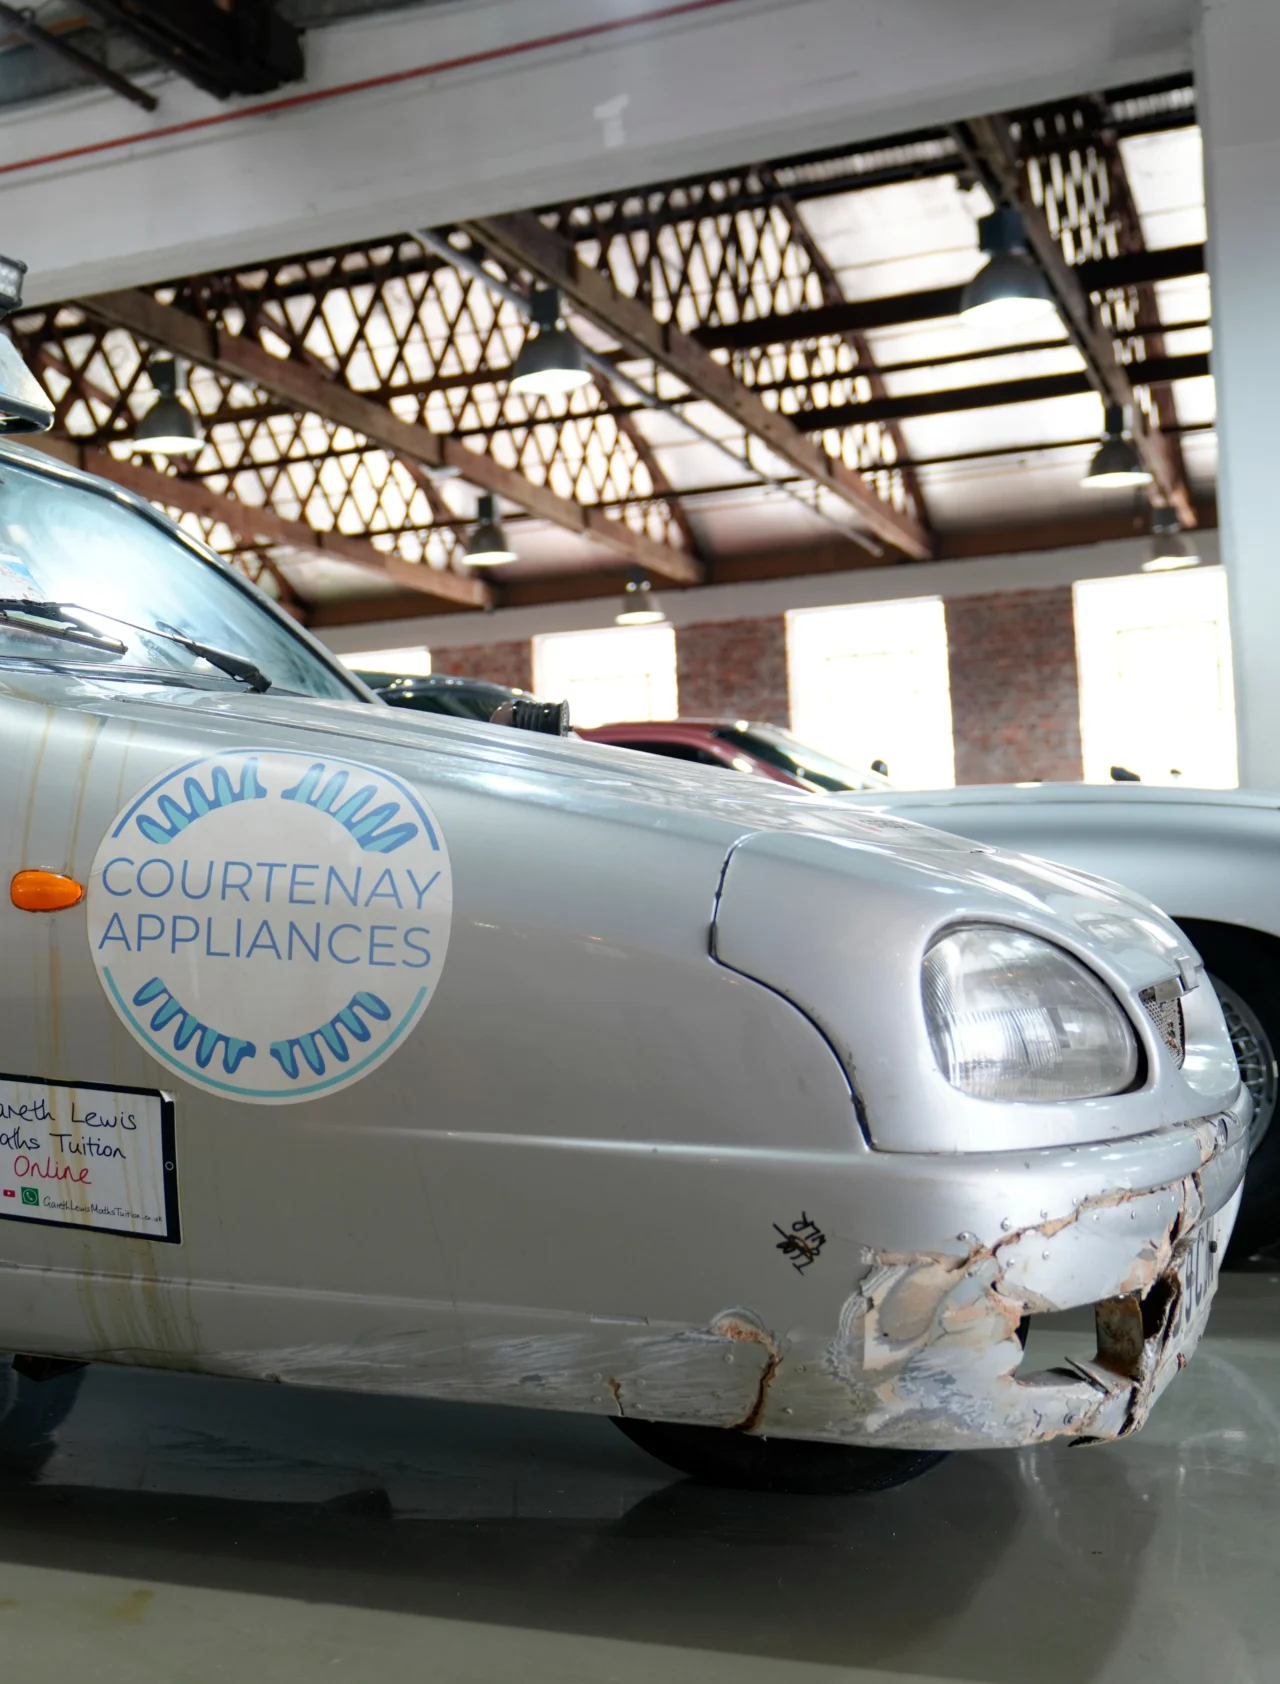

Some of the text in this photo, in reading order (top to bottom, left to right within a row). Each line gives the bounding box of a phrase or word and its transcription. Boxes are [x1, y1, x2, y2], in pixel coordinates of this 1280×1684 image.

[102, 857, 442, 911] COURTENAY
[97, 912, 431, 968] APPLIANCES
[71, 1102, 137, 1130] Lewis
[49, 1132, 126, 1159] Tuition
[14, 1155, 92, 1185] Online
[43, 1196, 163, 1222] GarethLewisMathsTuition.co.uk
